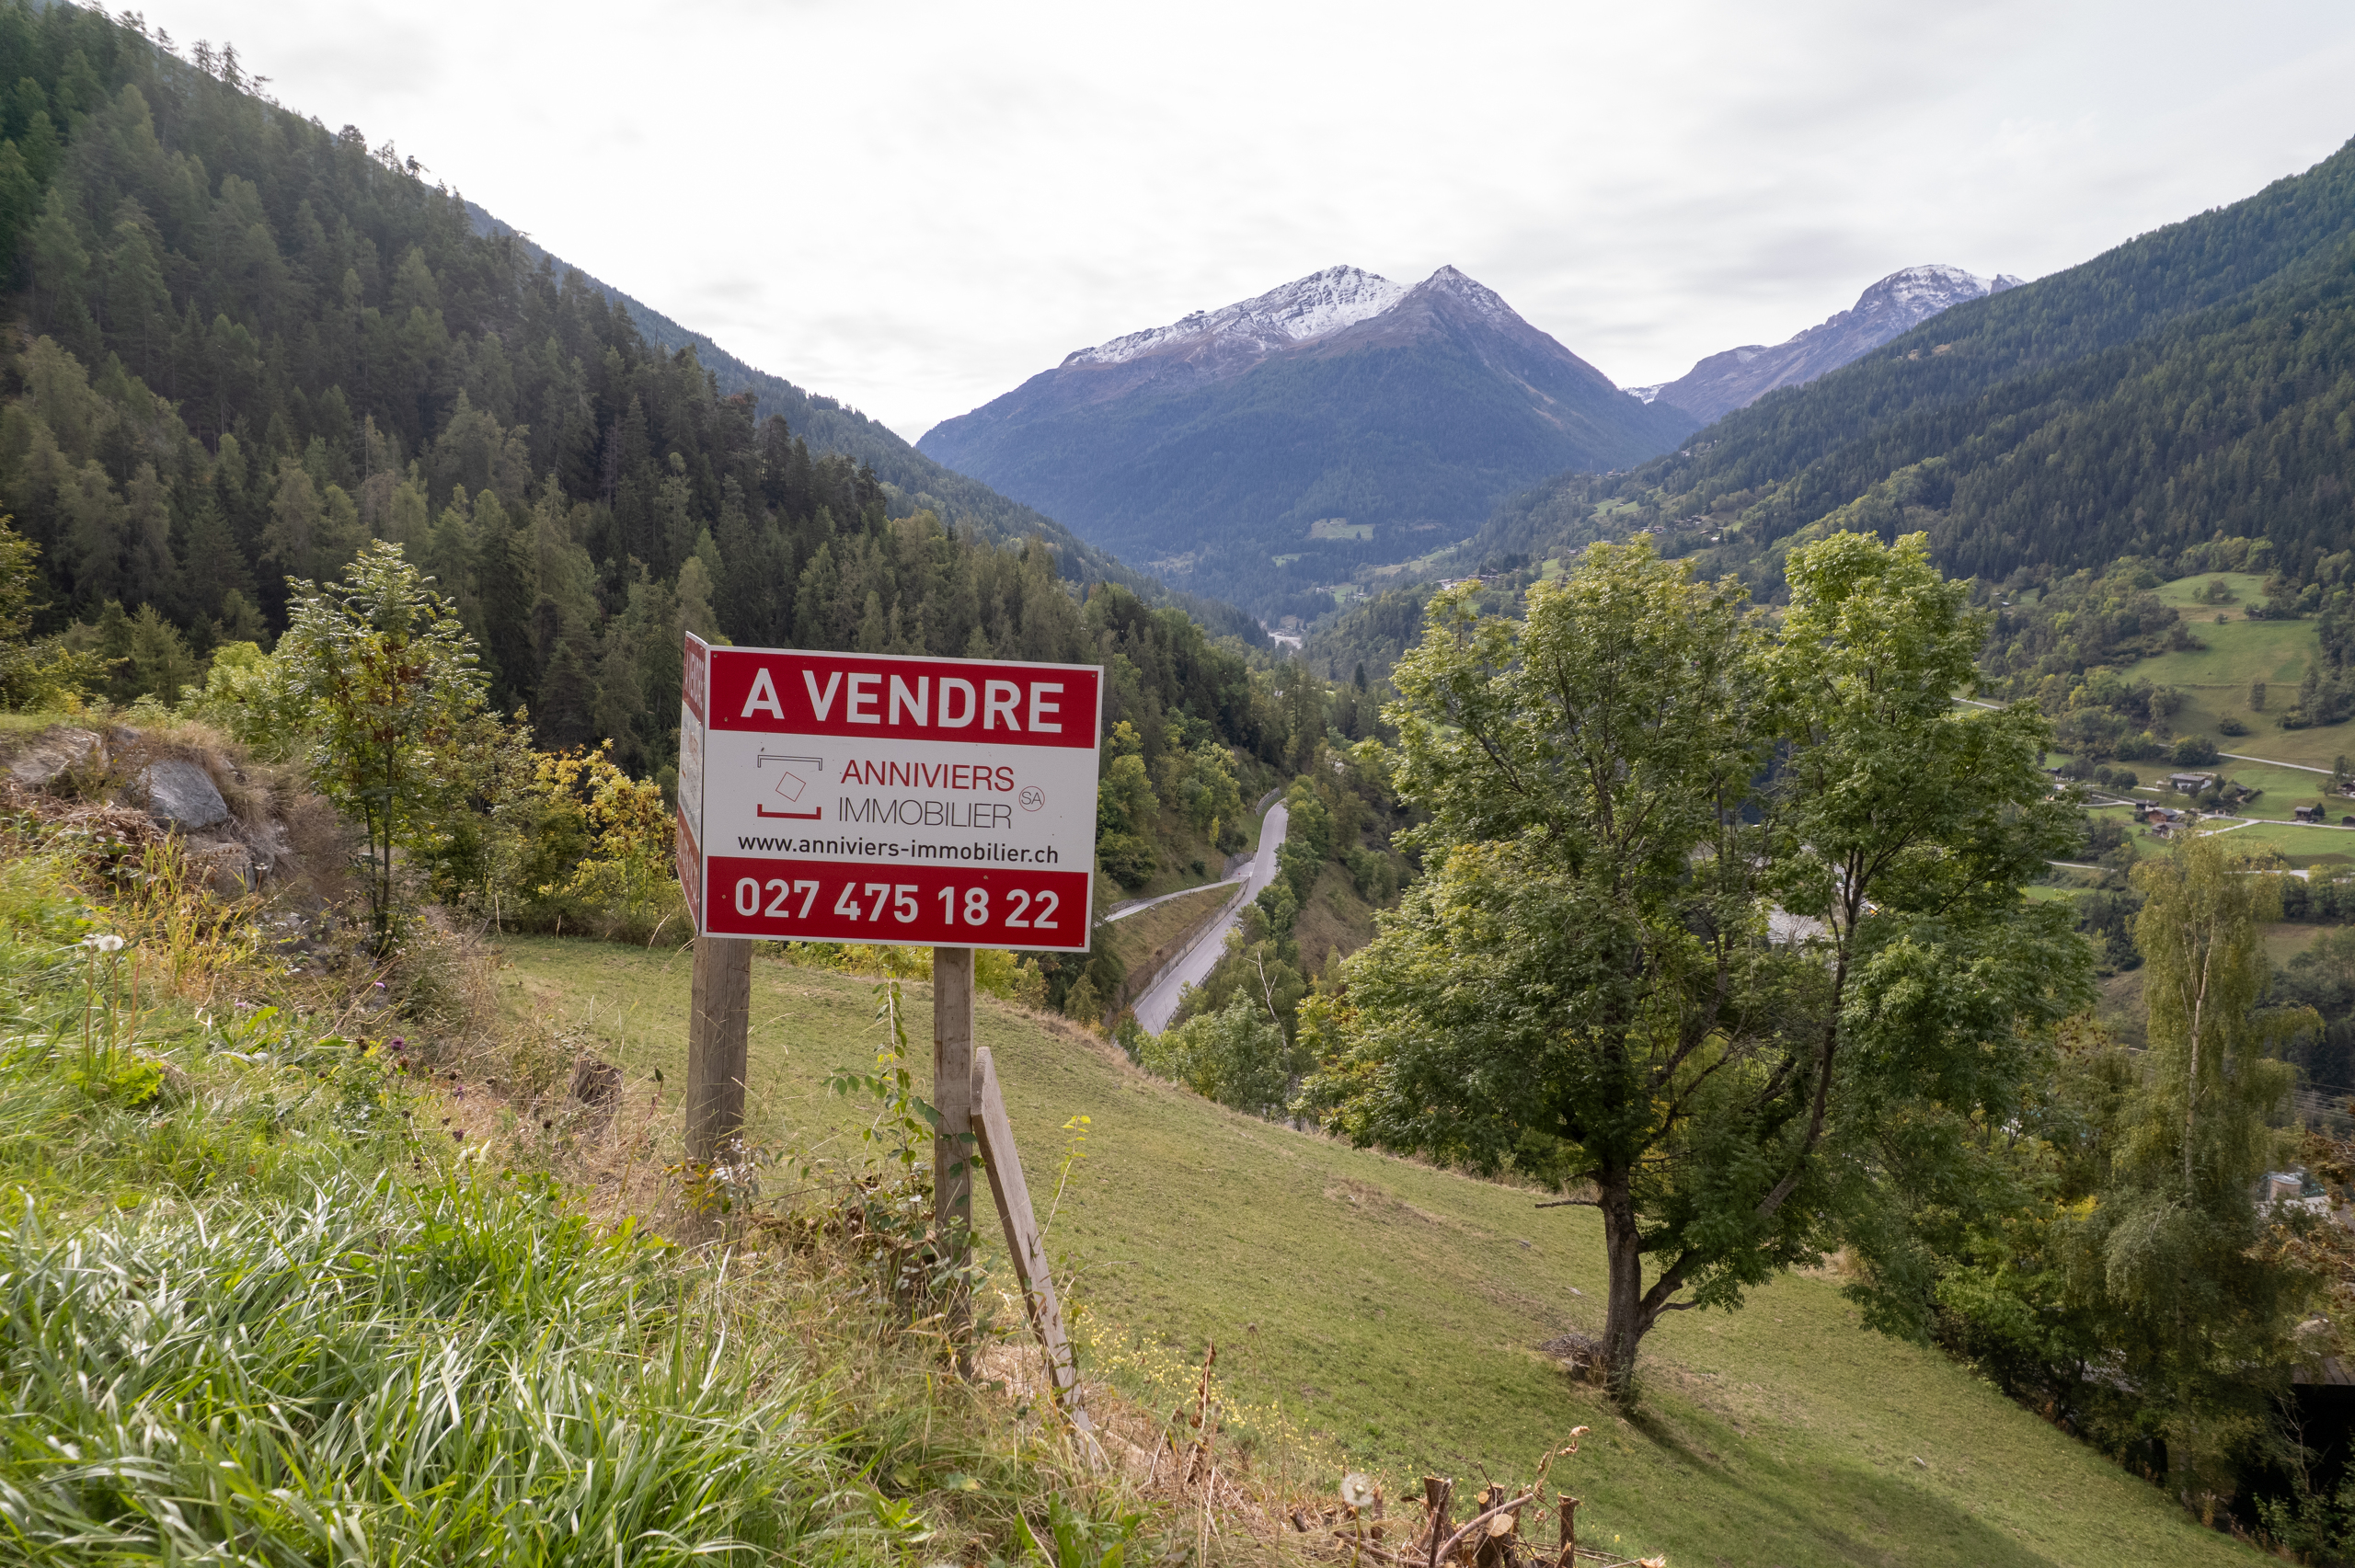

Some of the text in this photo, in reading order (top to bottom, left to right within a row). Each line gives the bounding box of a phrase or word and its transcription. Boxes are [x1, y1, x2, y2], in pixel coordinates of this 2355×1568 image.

[740, 668, 786, 720] A
[801, 670, 1064, 734] VENDRE
[840, 759, 1016, 793] ANNIVIERS
[838, 796, 1013, 830] IMMOBILIER
[1020, 790, 1042, 806] SA
[737, 835, 1060, 864] www.anniviers-immobilier.ch
[735, 877, 1060, 930] 027 475 18 22
